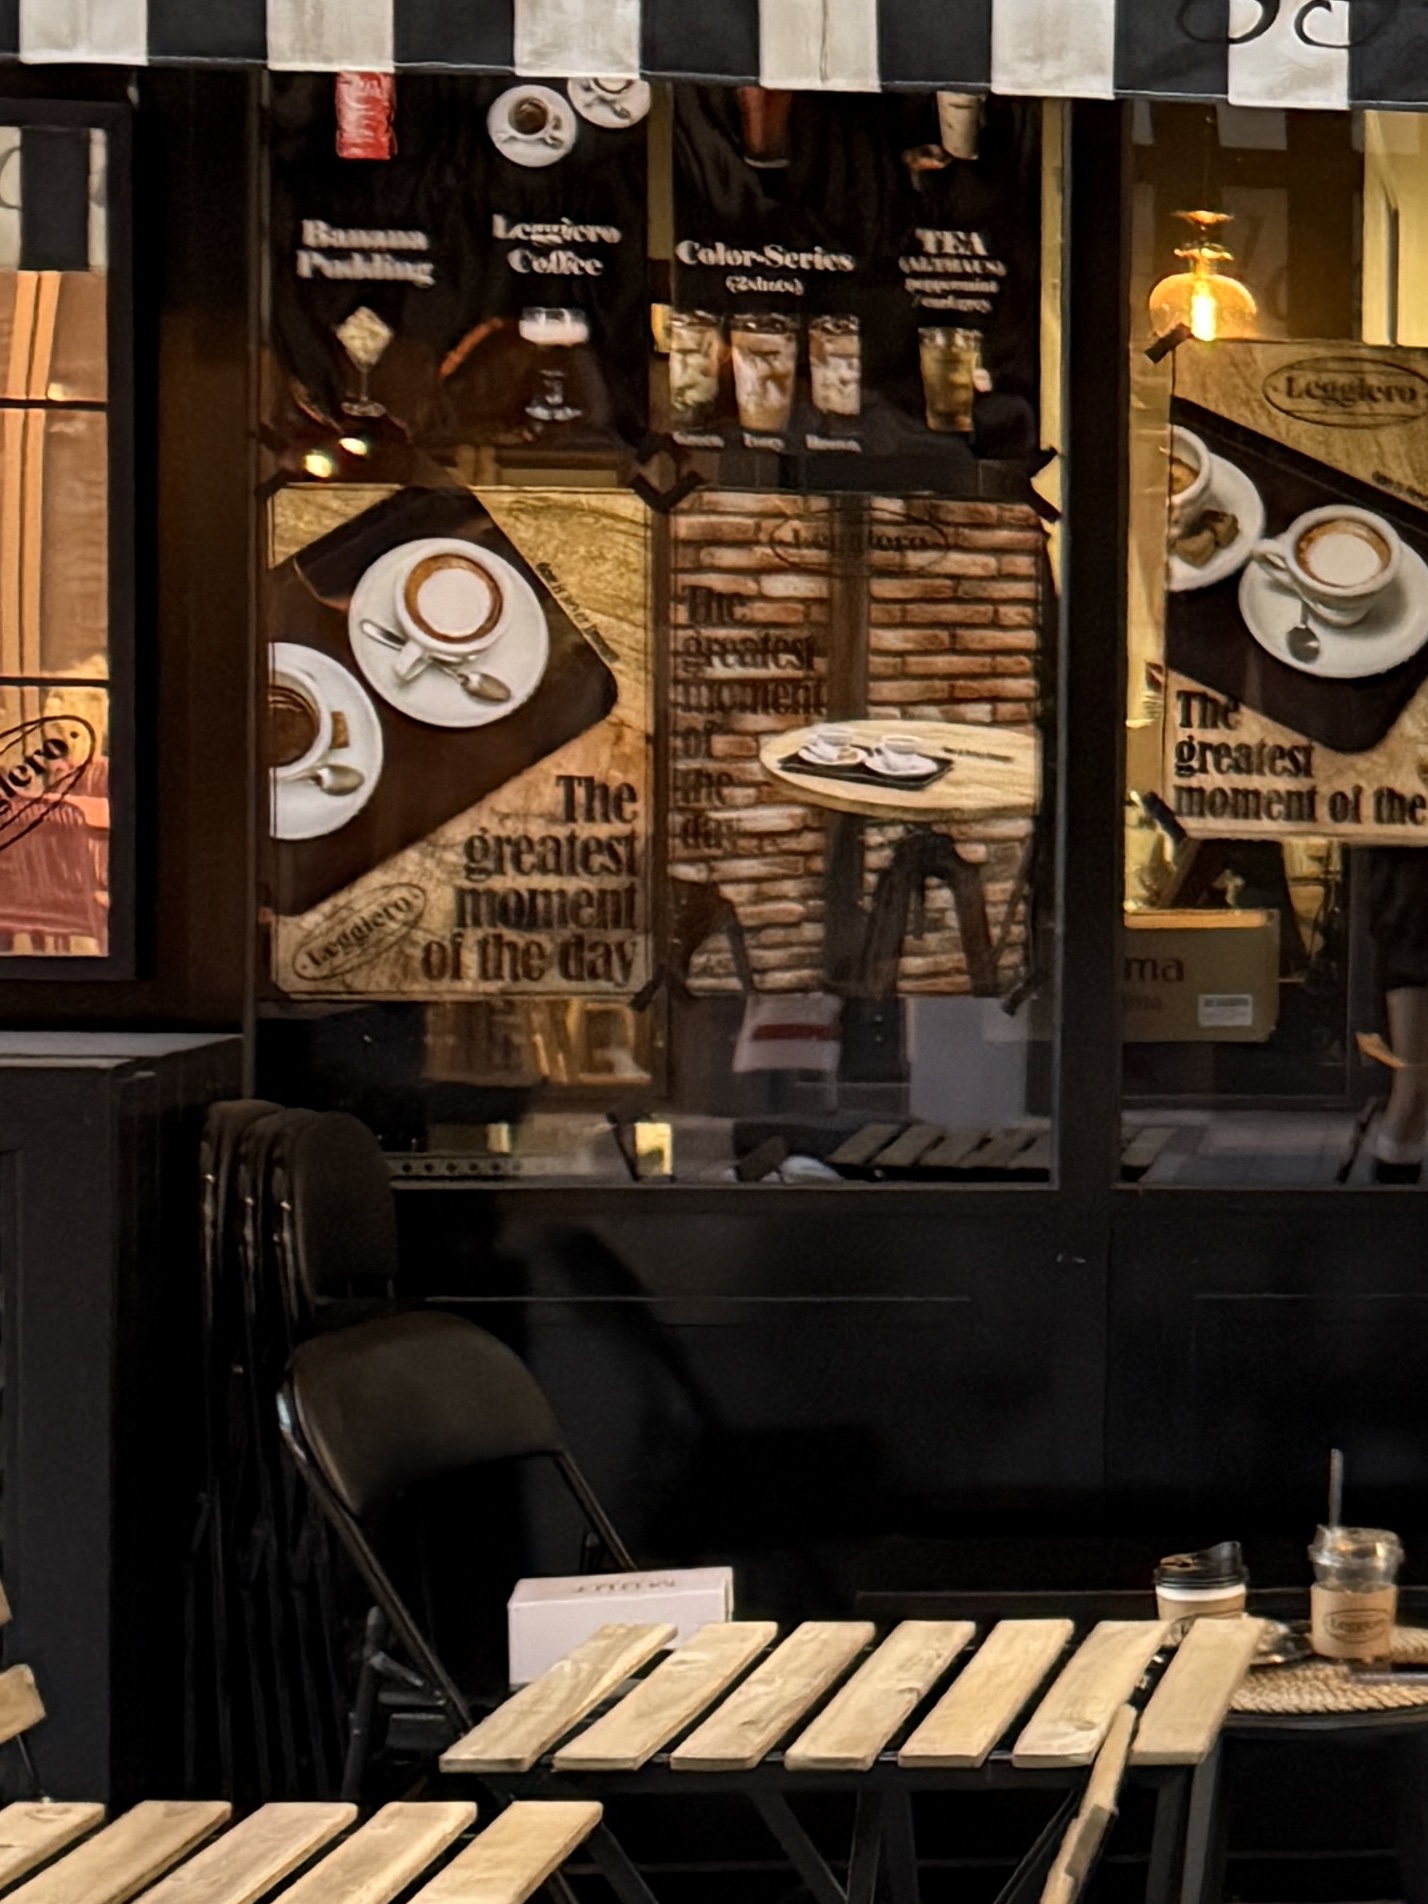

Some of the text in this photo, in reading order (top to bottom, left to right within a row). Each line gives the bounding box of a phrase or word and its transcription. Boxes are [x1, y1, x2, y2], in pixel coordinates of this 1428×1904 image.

[1176, 691, 1241, 729] The
[1175, 736, 1316, 778] greatest
[555, 776, 639, 824] The
[1173, 786, 1318, 822] moment
[1328, 787, 1362, 824] of
[1374, 788, 1428, 826] the
[463, 827, 638, 880] greatest
[306, 895, 413, 968] Leggiero
[455, 886, 638, 931] moment
[421, 936, 637, 986] of the day
